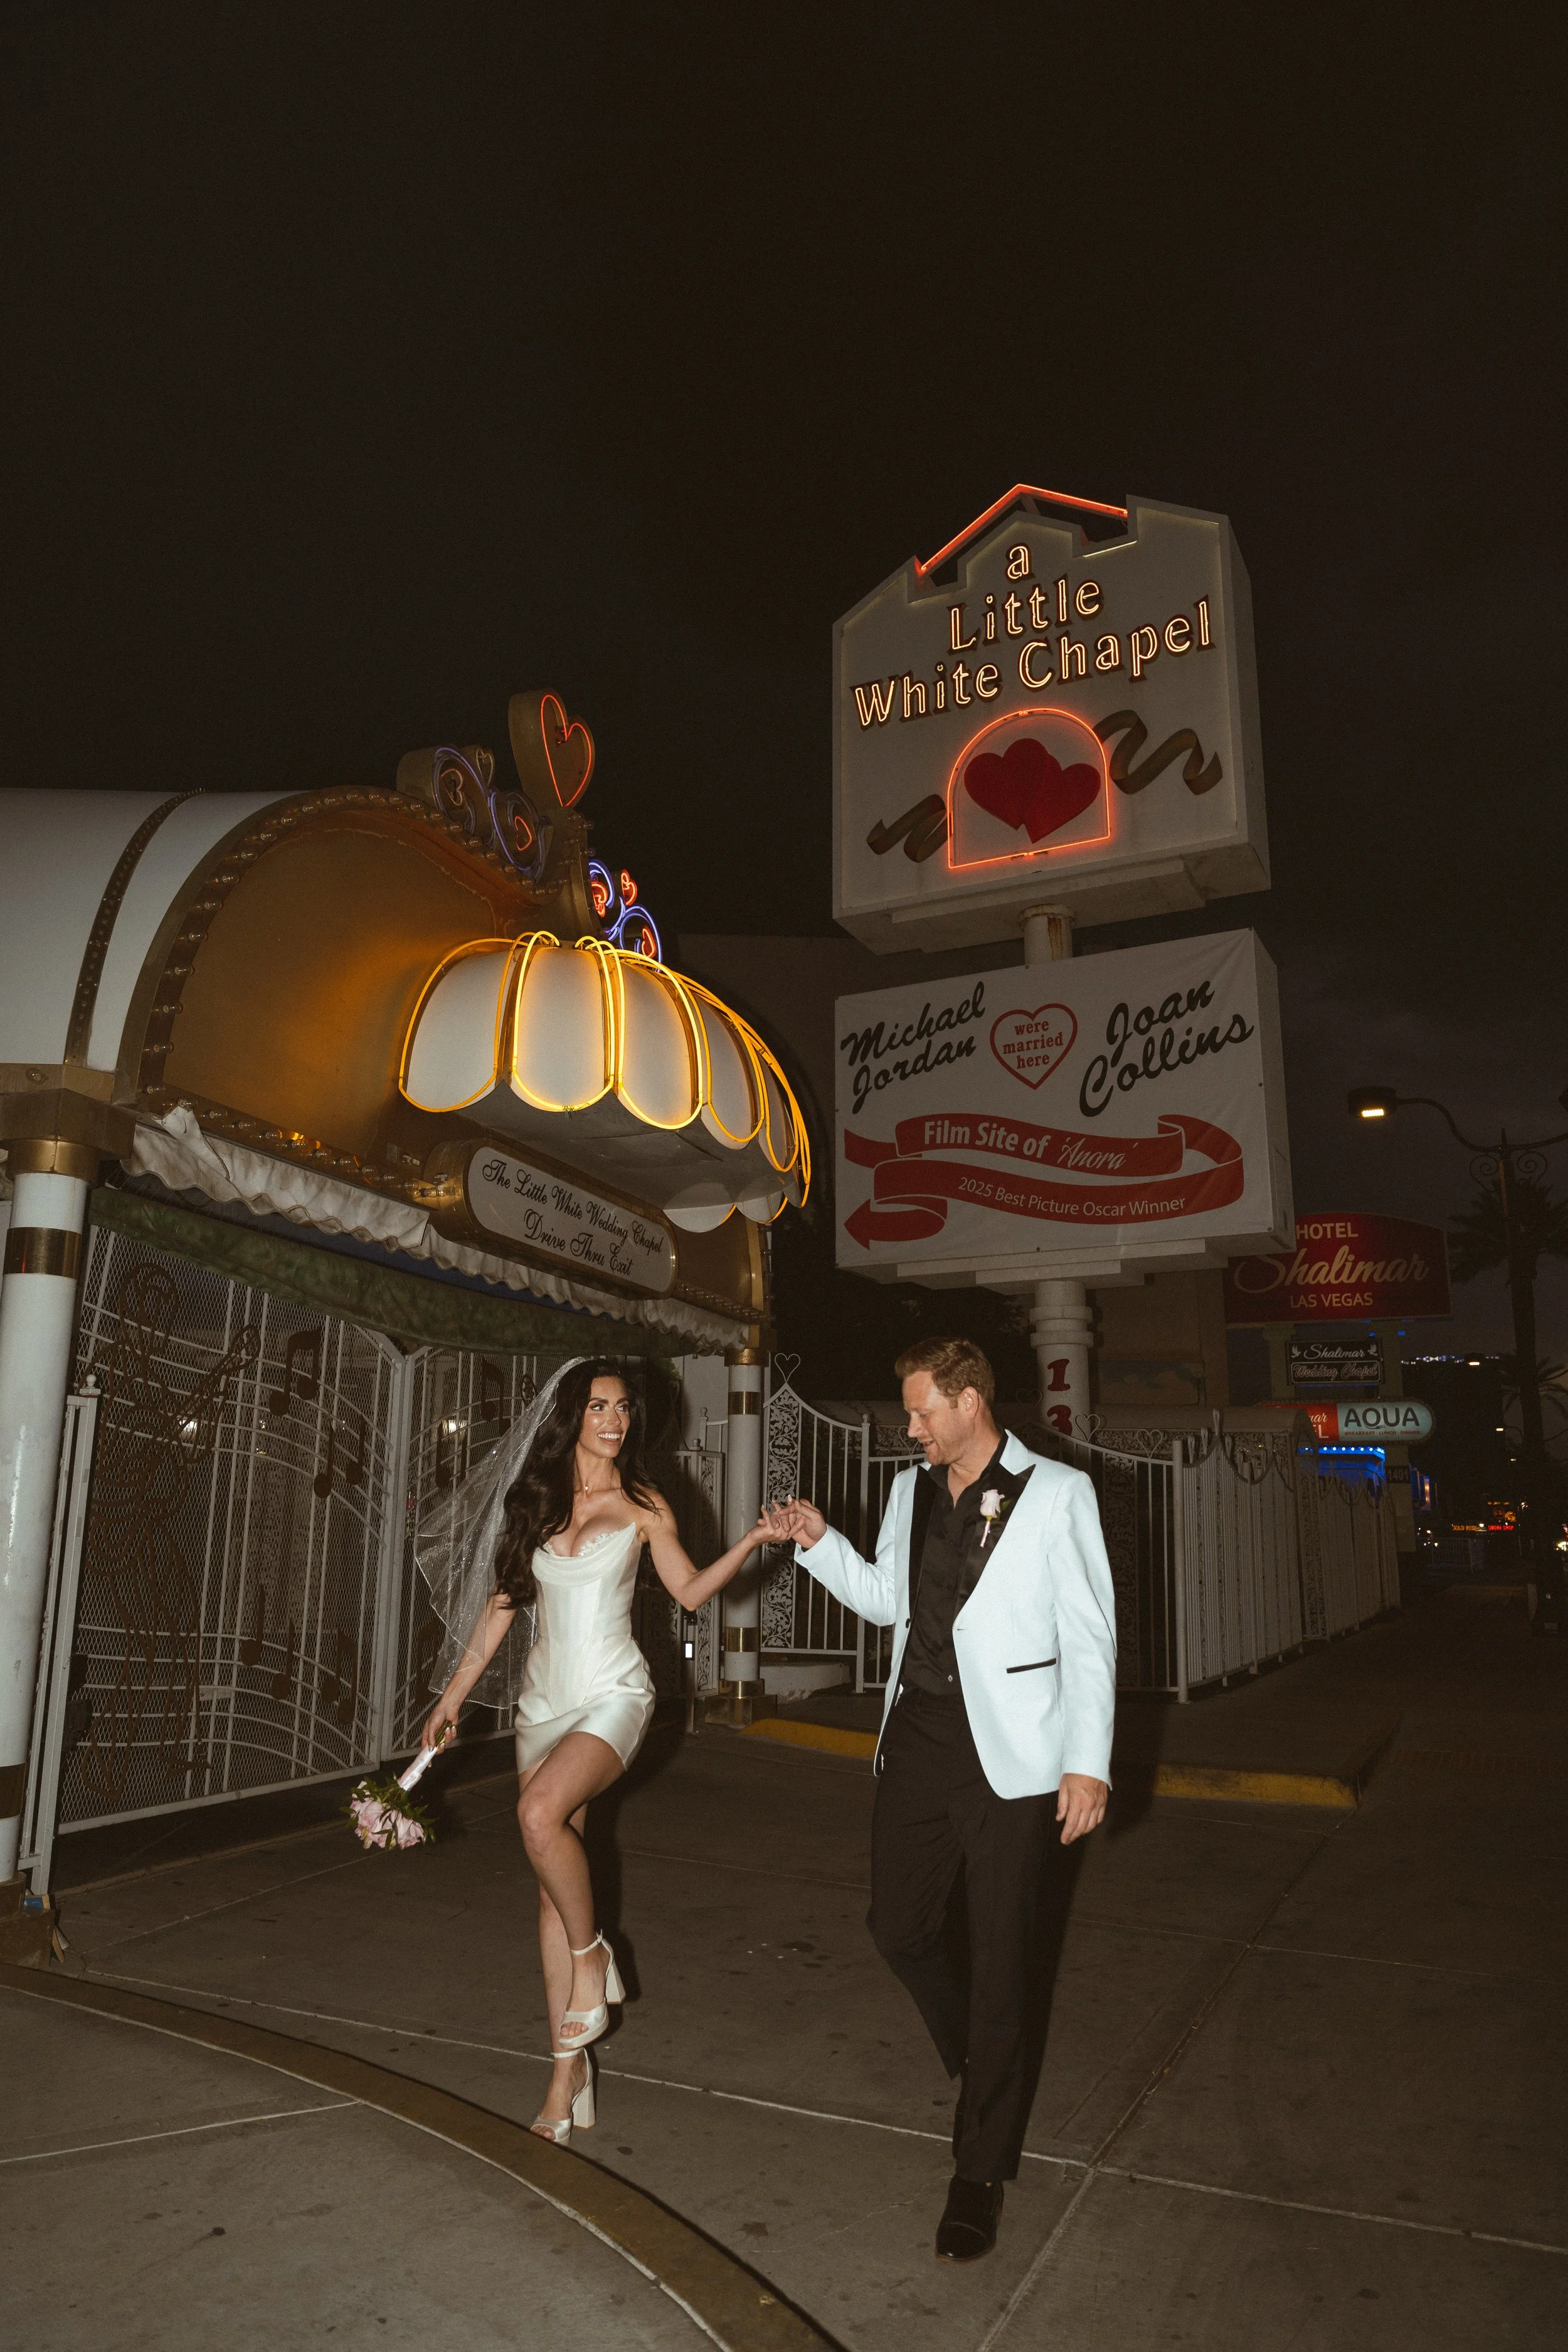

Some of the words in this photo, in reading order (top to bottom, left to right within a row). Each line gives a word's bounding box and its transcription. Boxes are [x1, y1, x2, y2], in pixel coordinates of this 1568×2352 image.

[1007, 542, 1033, 582] a
[946, 578, 1102, 655] Little
[850, 662, 1002, 731] White
[1017, 595, 1216, 691] Chapel
[840, 981, 985, 1066] Michael
[1002, 1032, 1063, 1054] married
[1014, 1020, 1049, 1036] were
[1106, 980, 1215, 1067] Joan
[852, 1036, 977, 1114] Jordan
[1016, 1052, 1050, 1069] here
[1079, 1014, 1254, 1117] Collins
[924, 1120, 970, 1145] Film
[975, 1121, 1019, 1151] Site
[1023, 1135, 1051, 1158] of
[482, 1160, 511, 1189] The
[514, 1169, 547, 1204] Little
[552, 1185, 582, 1219] White
[586, 1201, 628, 1245] Wedding
[632, 1221, 664, 1256] Chapel
[958, 1177, 993, 1197] 2025
[995, 1187, 1025, 1207] Best
[1028, 1195, 1079, 1215] Picture
[1083, 1201, 1126, 1217] Oscar
[1129, 1196, 1185, 1216] Winner
[524, 1209, 565, 1251] Drive
[570, 1232, 605, 1266] Thru
[610, 1242, 633, 1276] Exit
[1296, 1222, 1358, 1240] HOTEL
[1234, 1245, 1429, 1293] Shalimar
[1291, 1295, 1317, 1308] LAS
[1321, 1292, 1373, 1307] VEGAS
[1293, 1364, 1338, 1380] Wedding
[1340, 1362, 1378, 1380] Chapel
[1303, 1343, 1365, 1360] Shalimar
[1344, 1407, 1420, 1429] AQUA
